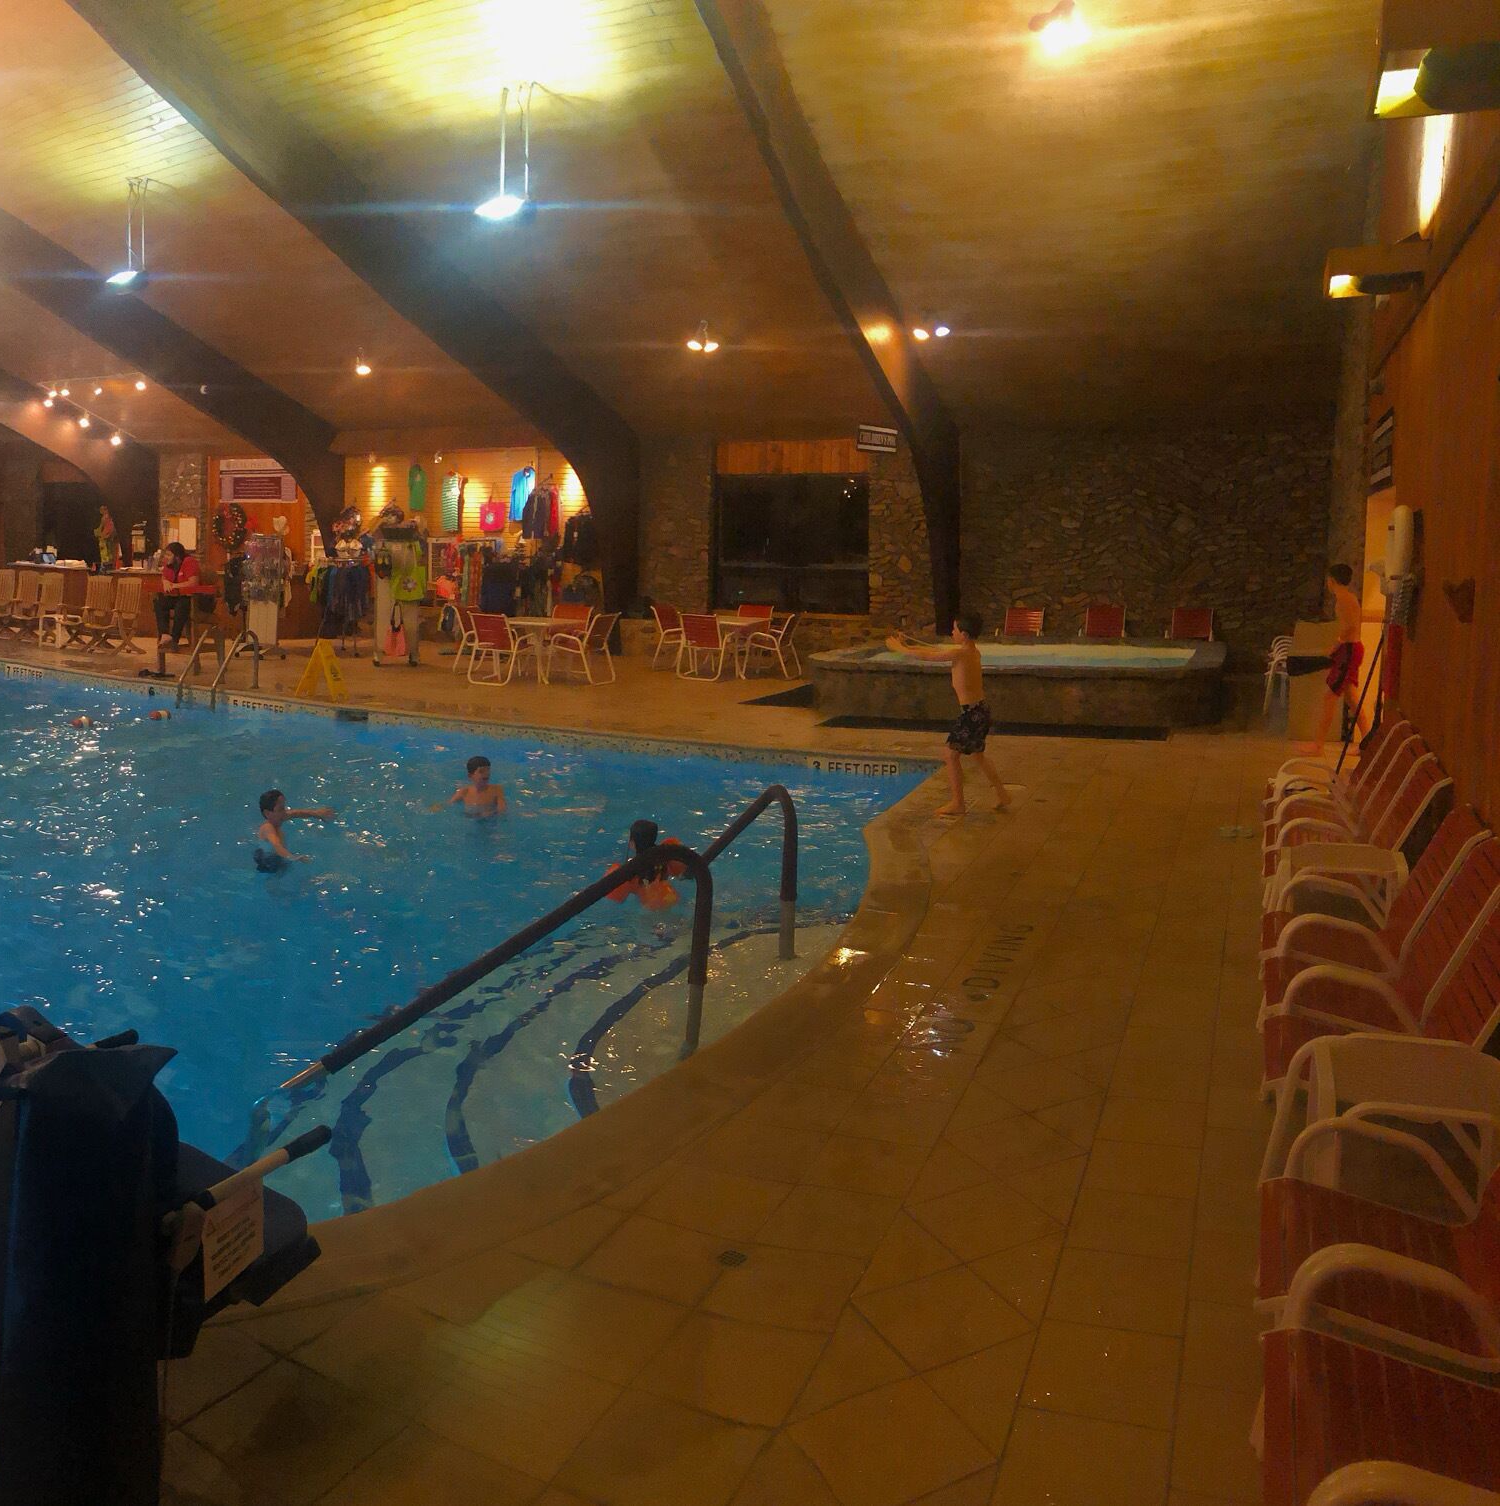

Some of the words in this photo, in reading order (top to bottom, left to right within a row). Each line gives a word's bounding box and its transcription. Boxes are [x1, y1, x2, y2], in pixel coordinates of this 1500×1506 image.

[813, 761, 820, 770] 3
[828, 762, 860, 775] FEET
[863, 764, 897, 777] DEEP
